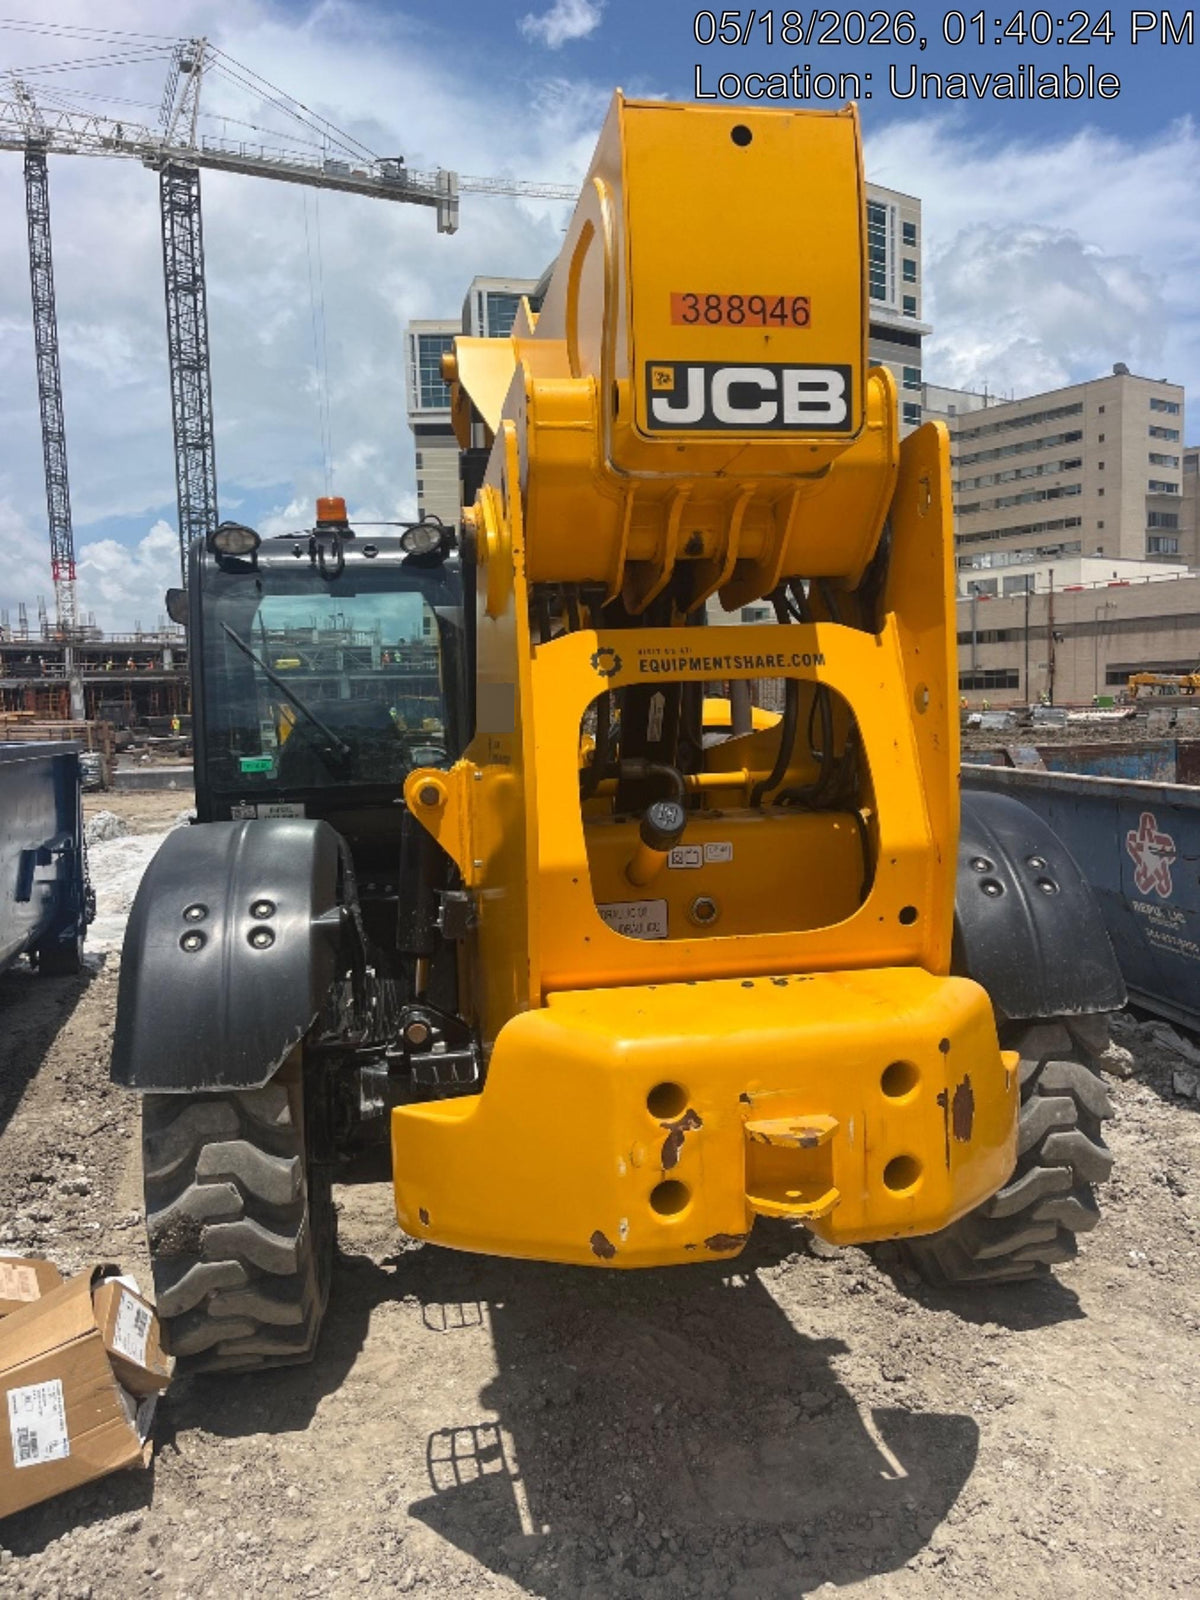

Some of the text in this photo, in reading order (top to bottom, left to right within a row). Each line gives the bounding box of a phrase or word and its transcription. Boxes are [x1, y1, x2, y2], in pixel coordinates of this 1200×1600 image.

[681, 293, 810, 326] 388946
[652, 367, 847, 424] JCB
[639, 653, 825, 673] EQUIPMENTSHARE.COM
